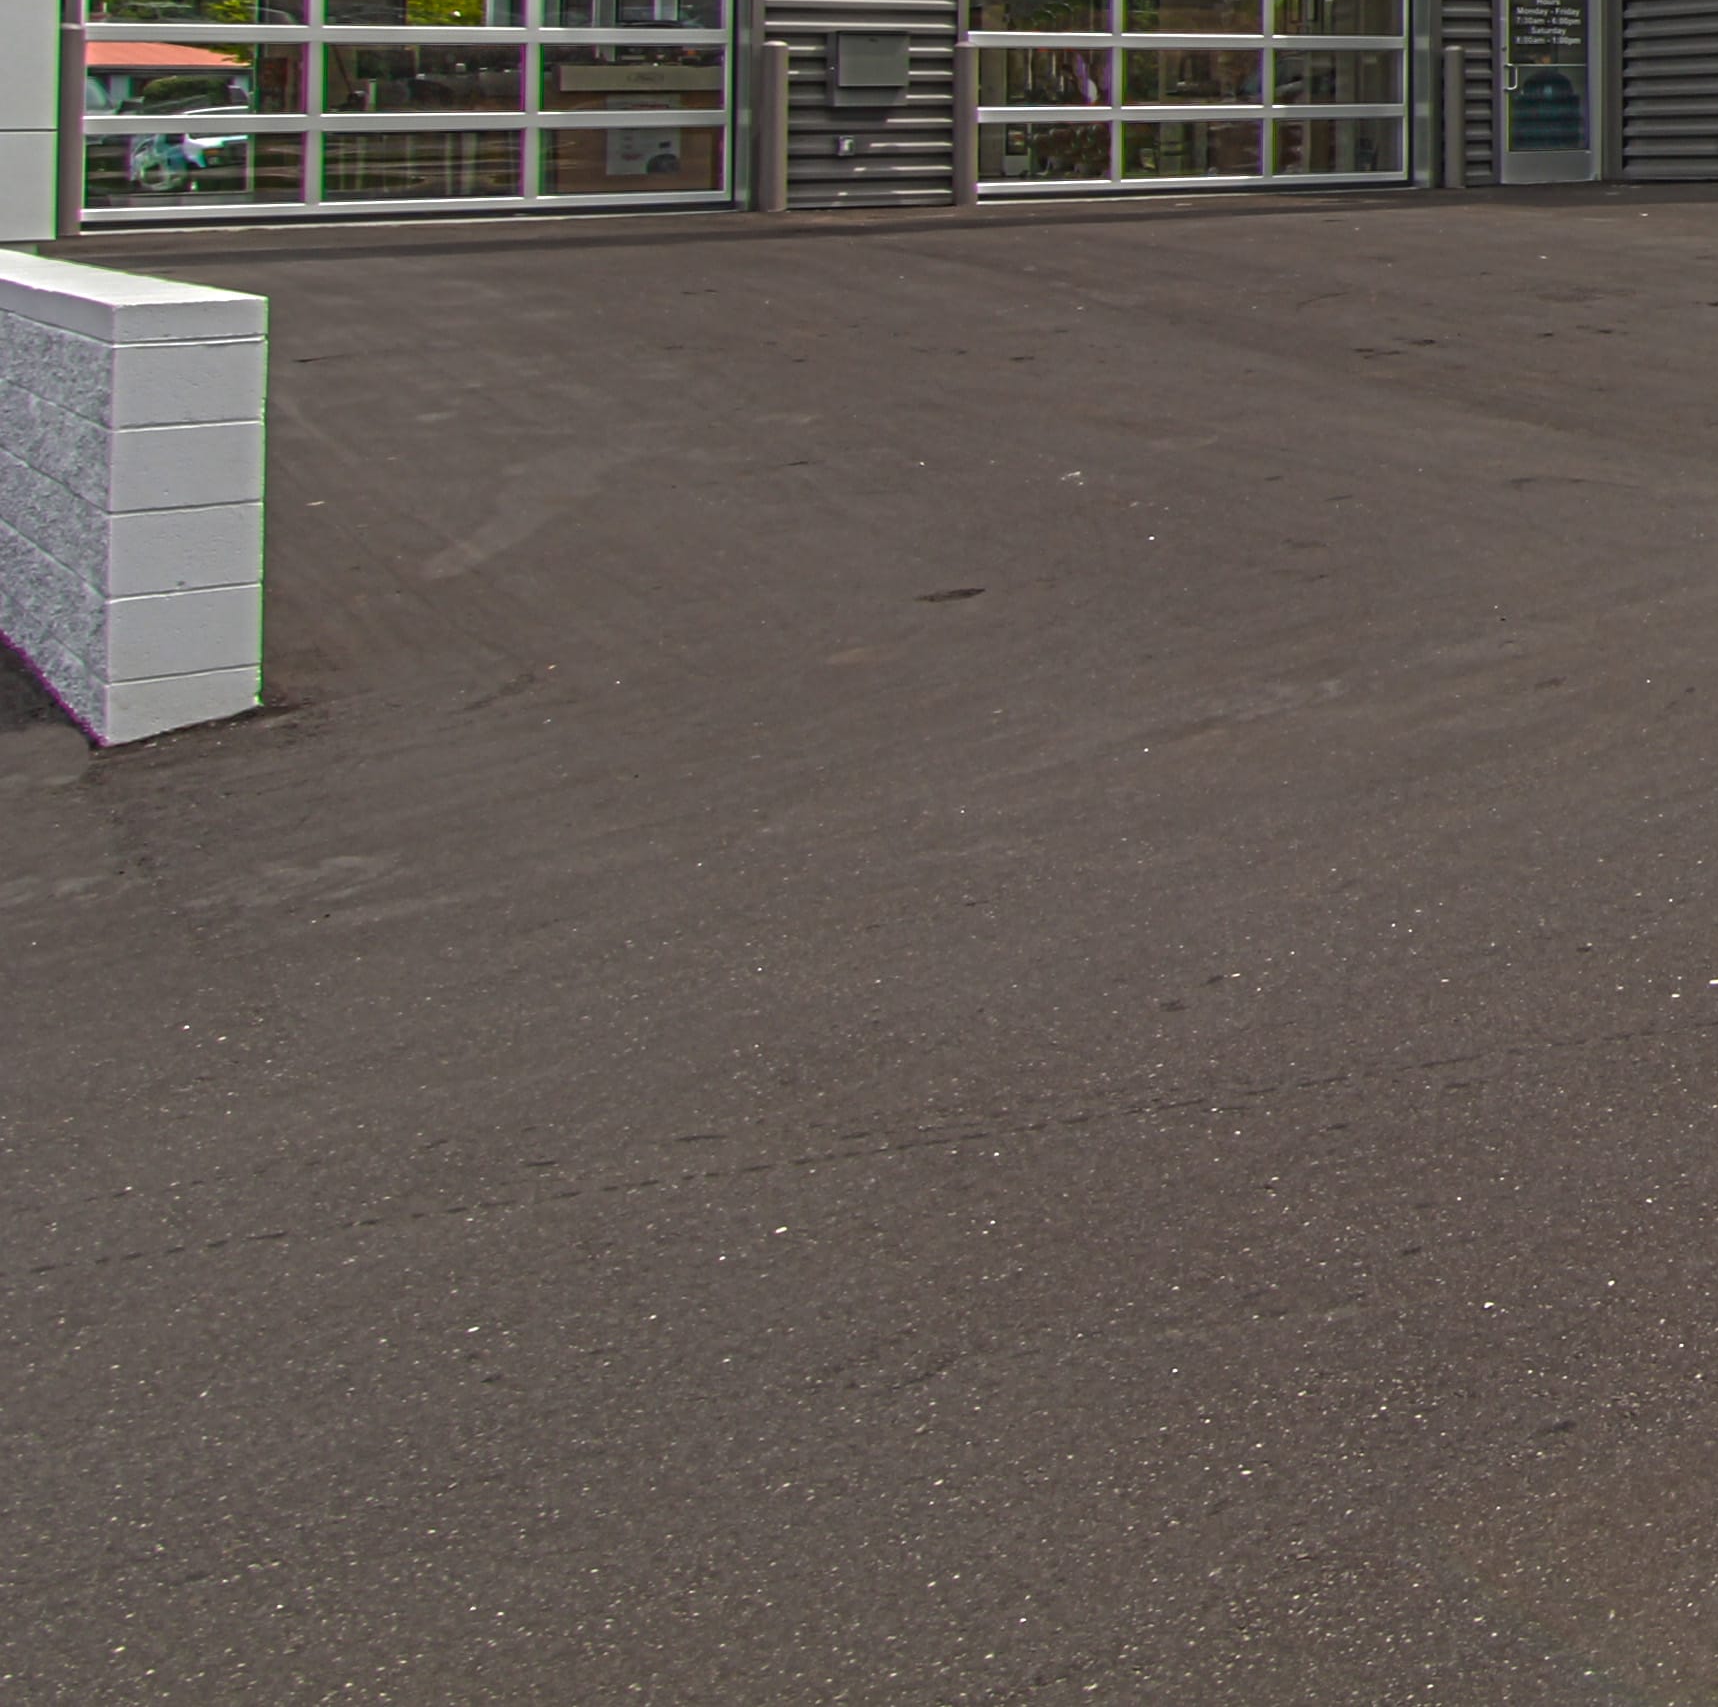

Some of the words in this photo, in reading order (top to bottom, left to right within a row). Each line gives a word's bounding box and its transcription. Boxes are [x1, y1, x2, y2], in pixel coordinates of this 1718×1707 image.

[1516, 7, 1547, 16] Monday
[1555, 7, 1579, 17] Friday
[1531, 26, 1567, 36] Saturday
